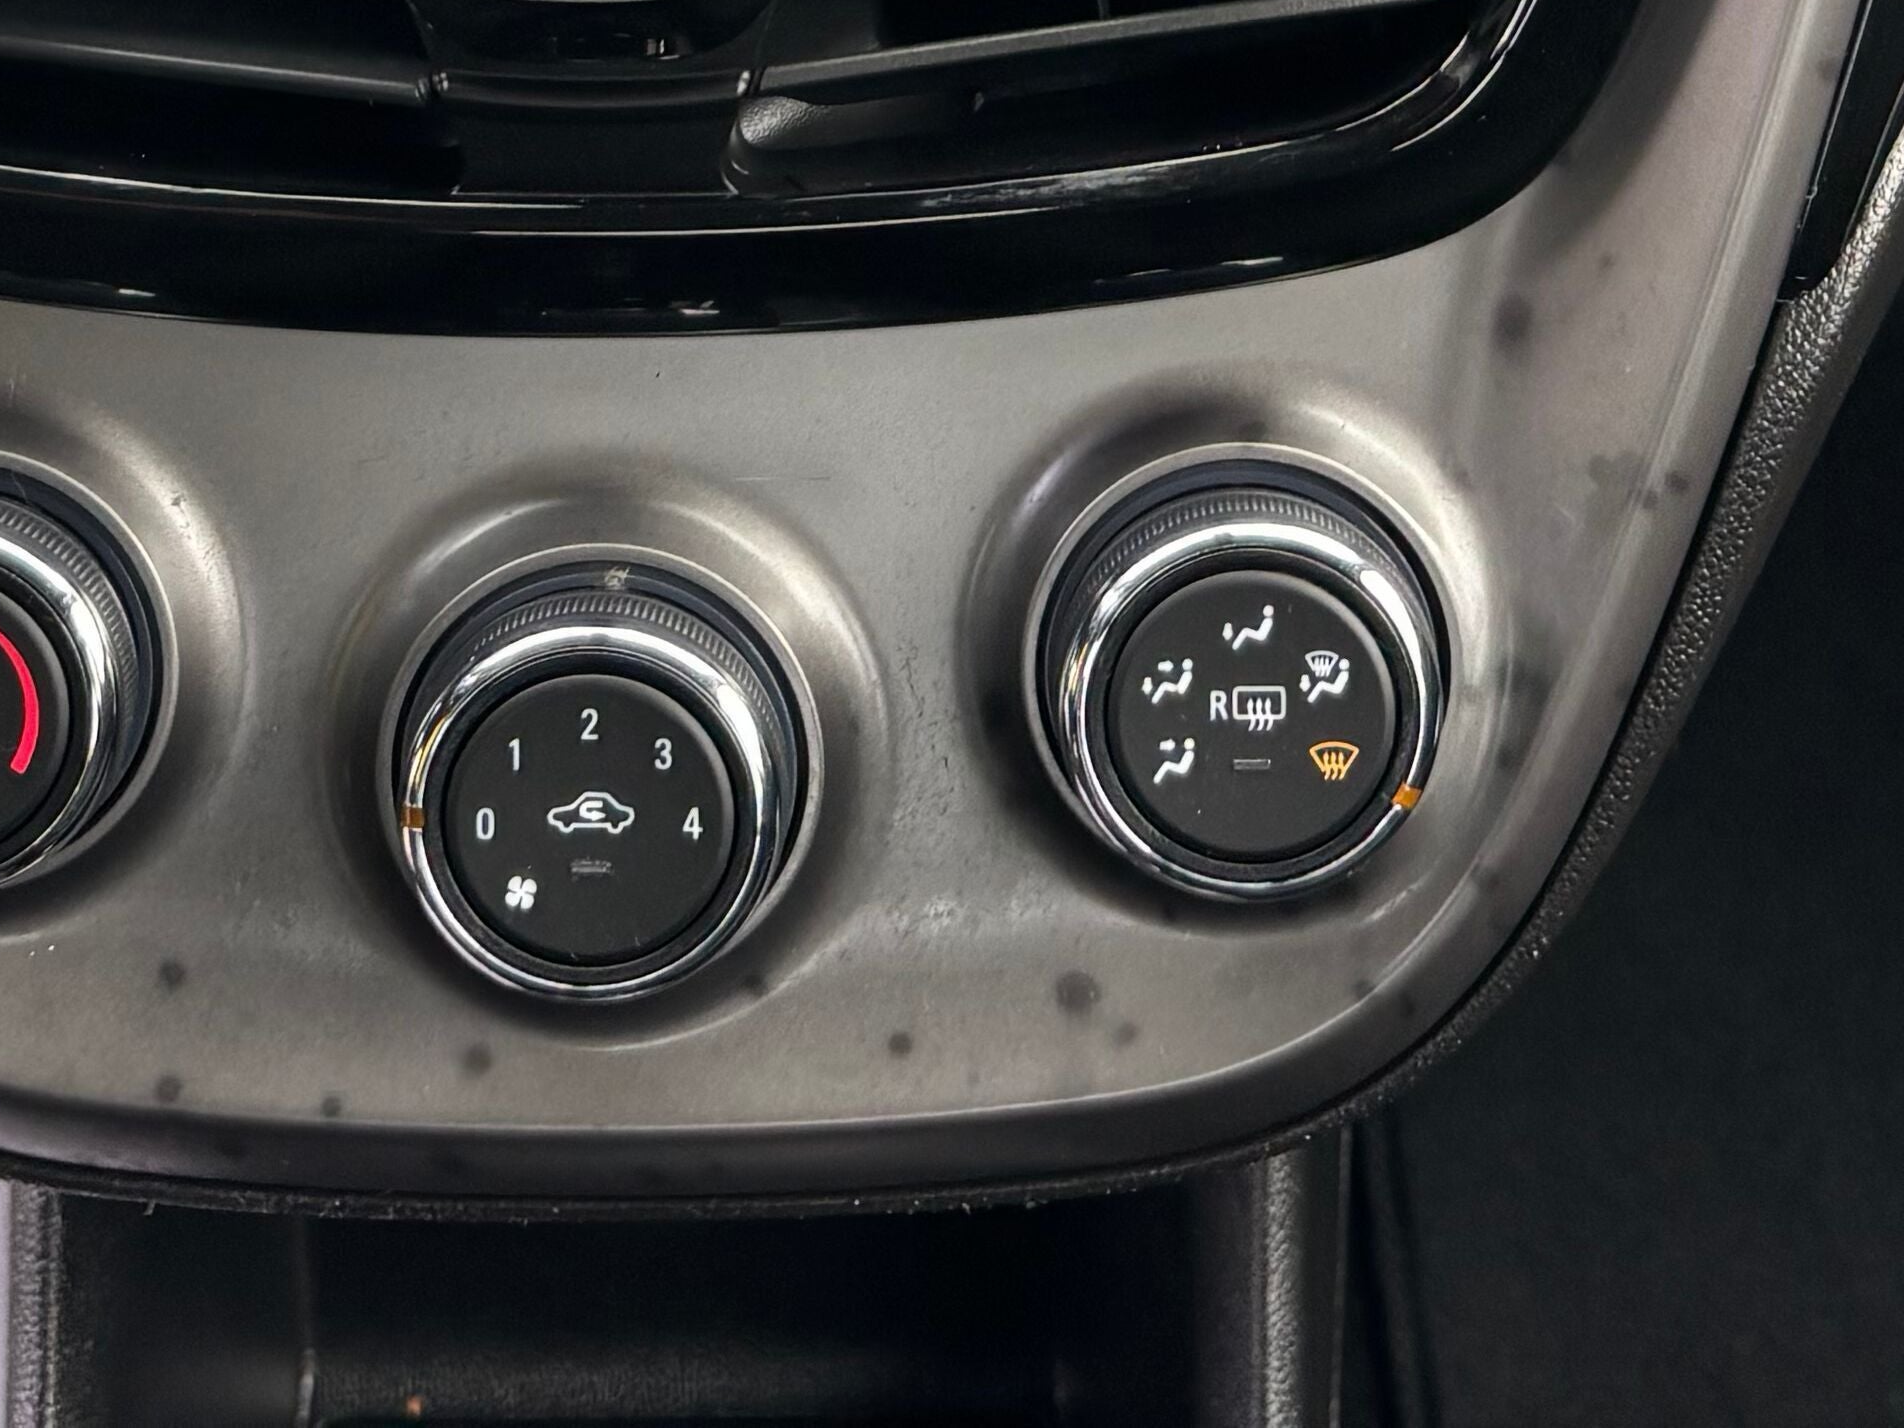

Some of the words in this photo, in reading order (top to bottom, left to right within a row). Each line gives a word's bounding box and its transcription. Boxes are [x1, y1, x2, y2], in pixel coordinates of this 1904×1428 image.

[1209, 690, 1229, 721] R
[580, 708, 599, 741] 2
[508, 738, 520, 771] 1
[654, 737, 673, 770] 3
[475, 807, 495, 841] 0
[682, 806, 704, 841] 4
